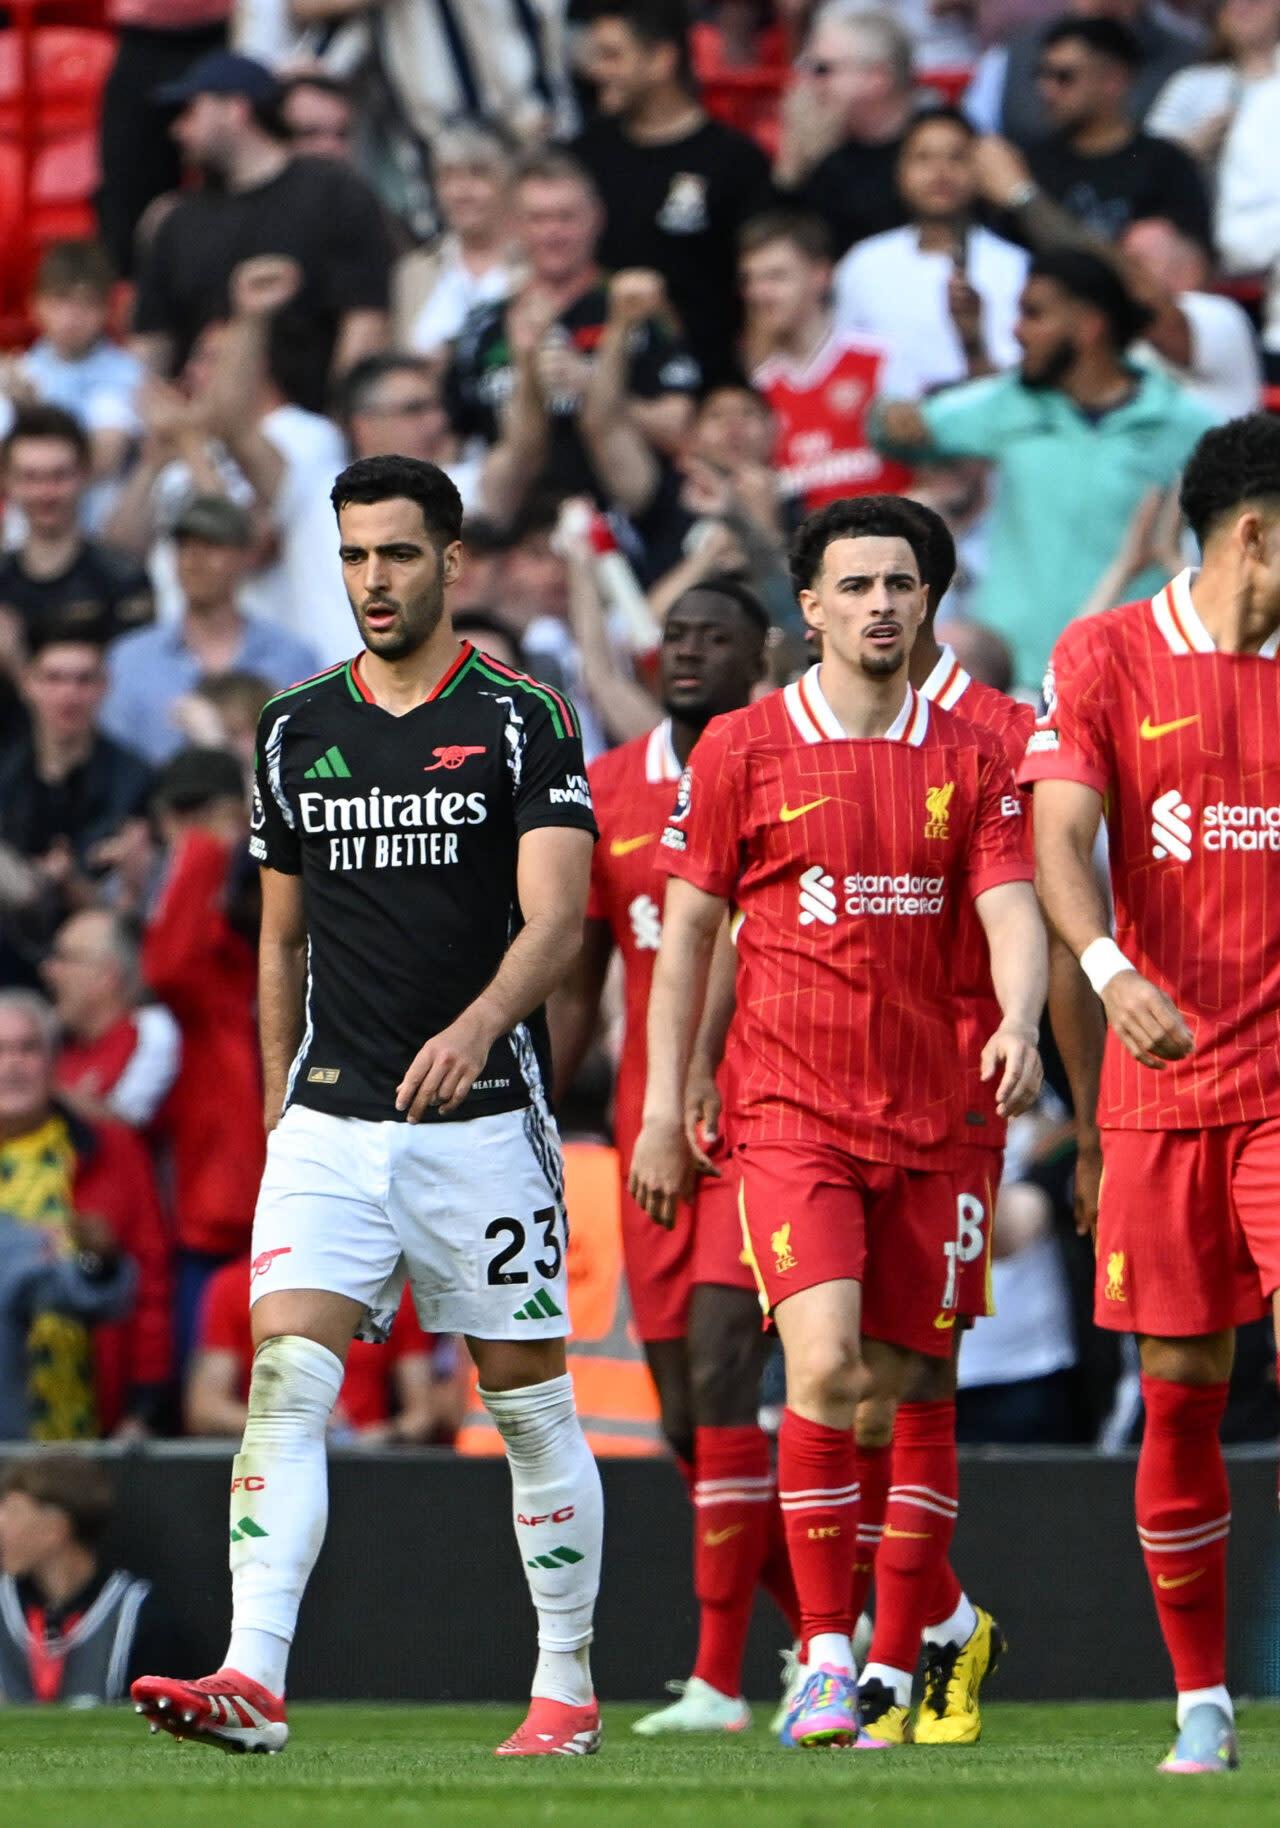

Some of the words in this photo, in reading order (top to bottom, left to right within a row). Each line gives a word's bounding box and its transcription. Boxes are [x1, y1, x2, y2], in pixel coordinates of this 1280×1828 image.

[299, 786, 487, 833] Emirates
[329, 836, 366, 871] FLY
[375, 832, 459, 868] BETTER
[843, 871, 945, 895] standard
[484, 1206, 561, 1286] 23
[517, 1505, 575, 1526] AFC
[808, 1526, 841, 1539] LFC
